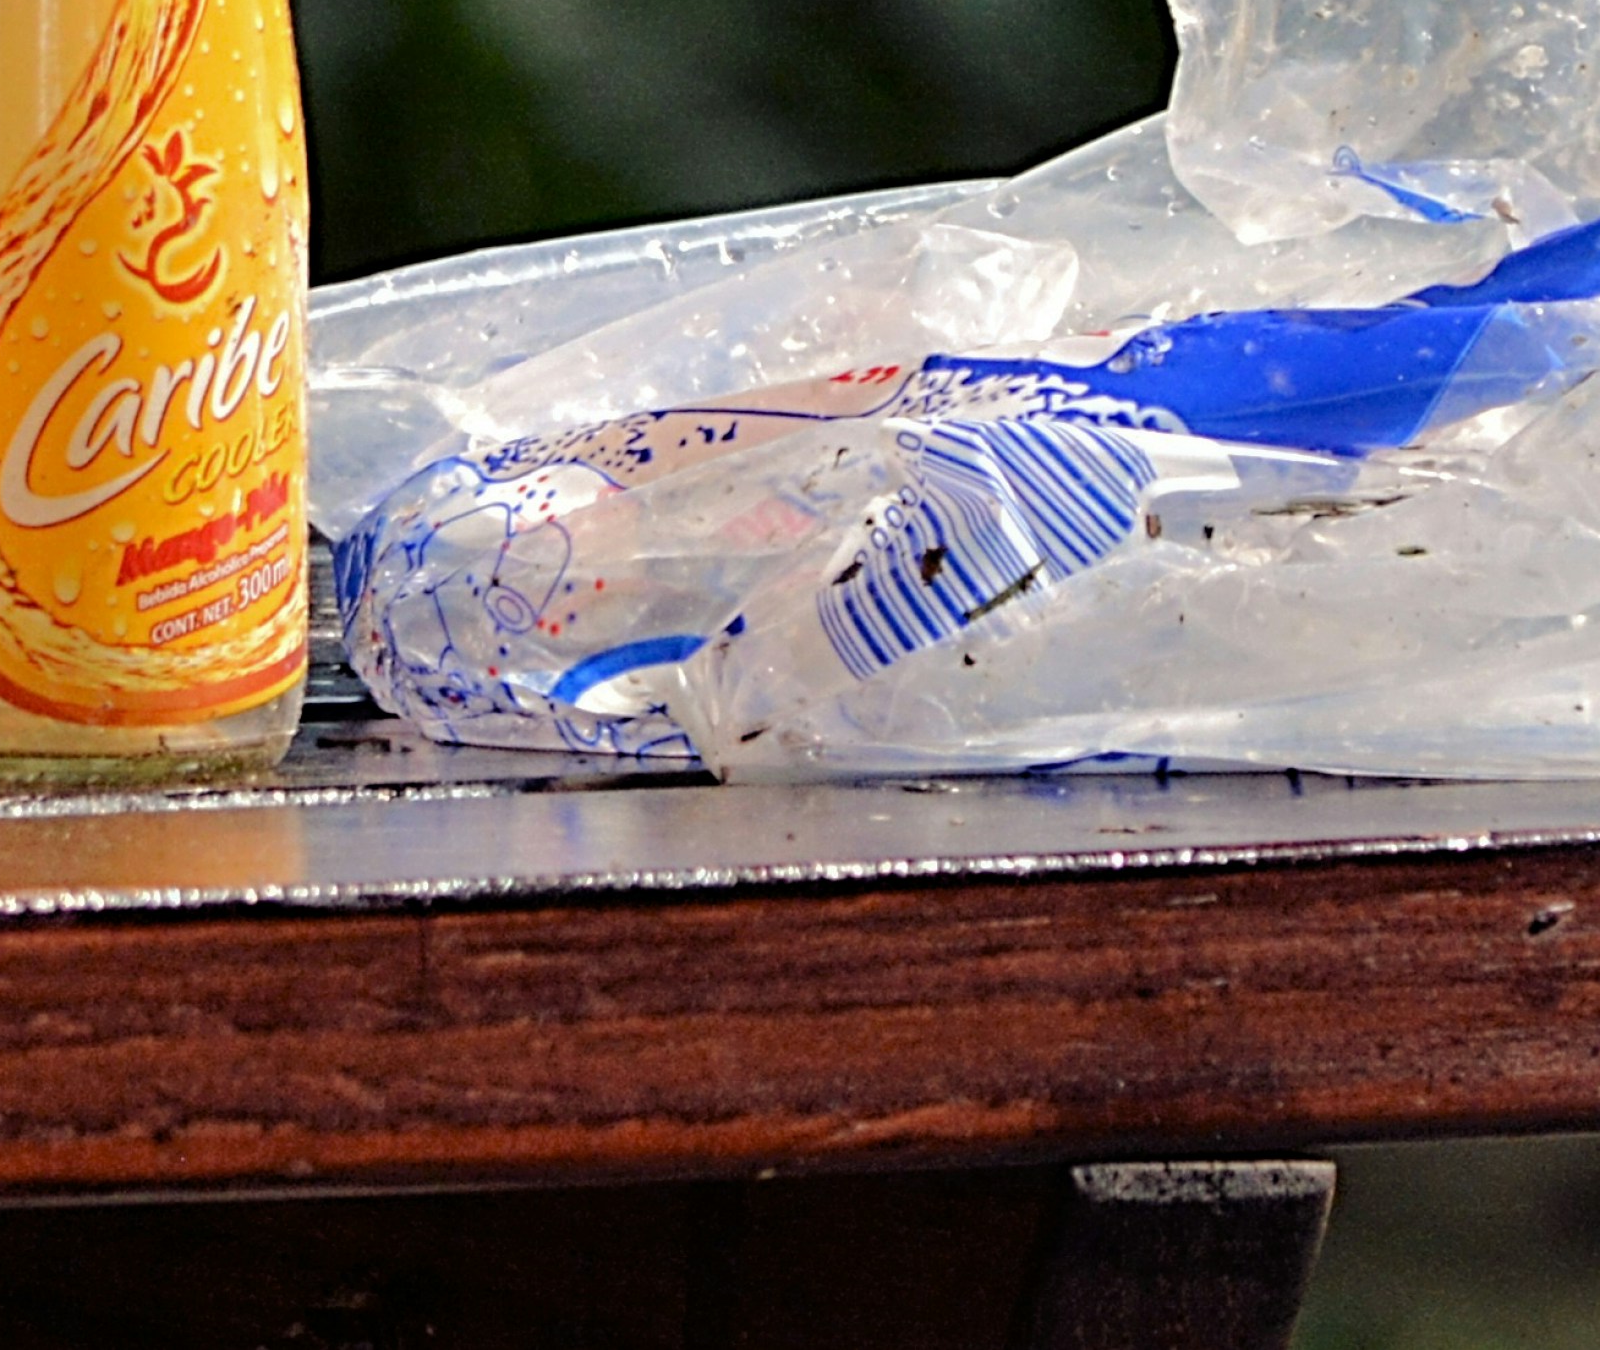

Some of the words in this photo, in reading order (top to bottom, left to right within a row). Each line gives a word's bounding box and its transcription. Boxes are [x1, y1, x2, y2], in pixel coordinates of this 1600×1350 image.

[0, 295, 291, 528] Caribe
[151, 611, 200, 644] CONT.
[202, 595, 236, 626] NET.
